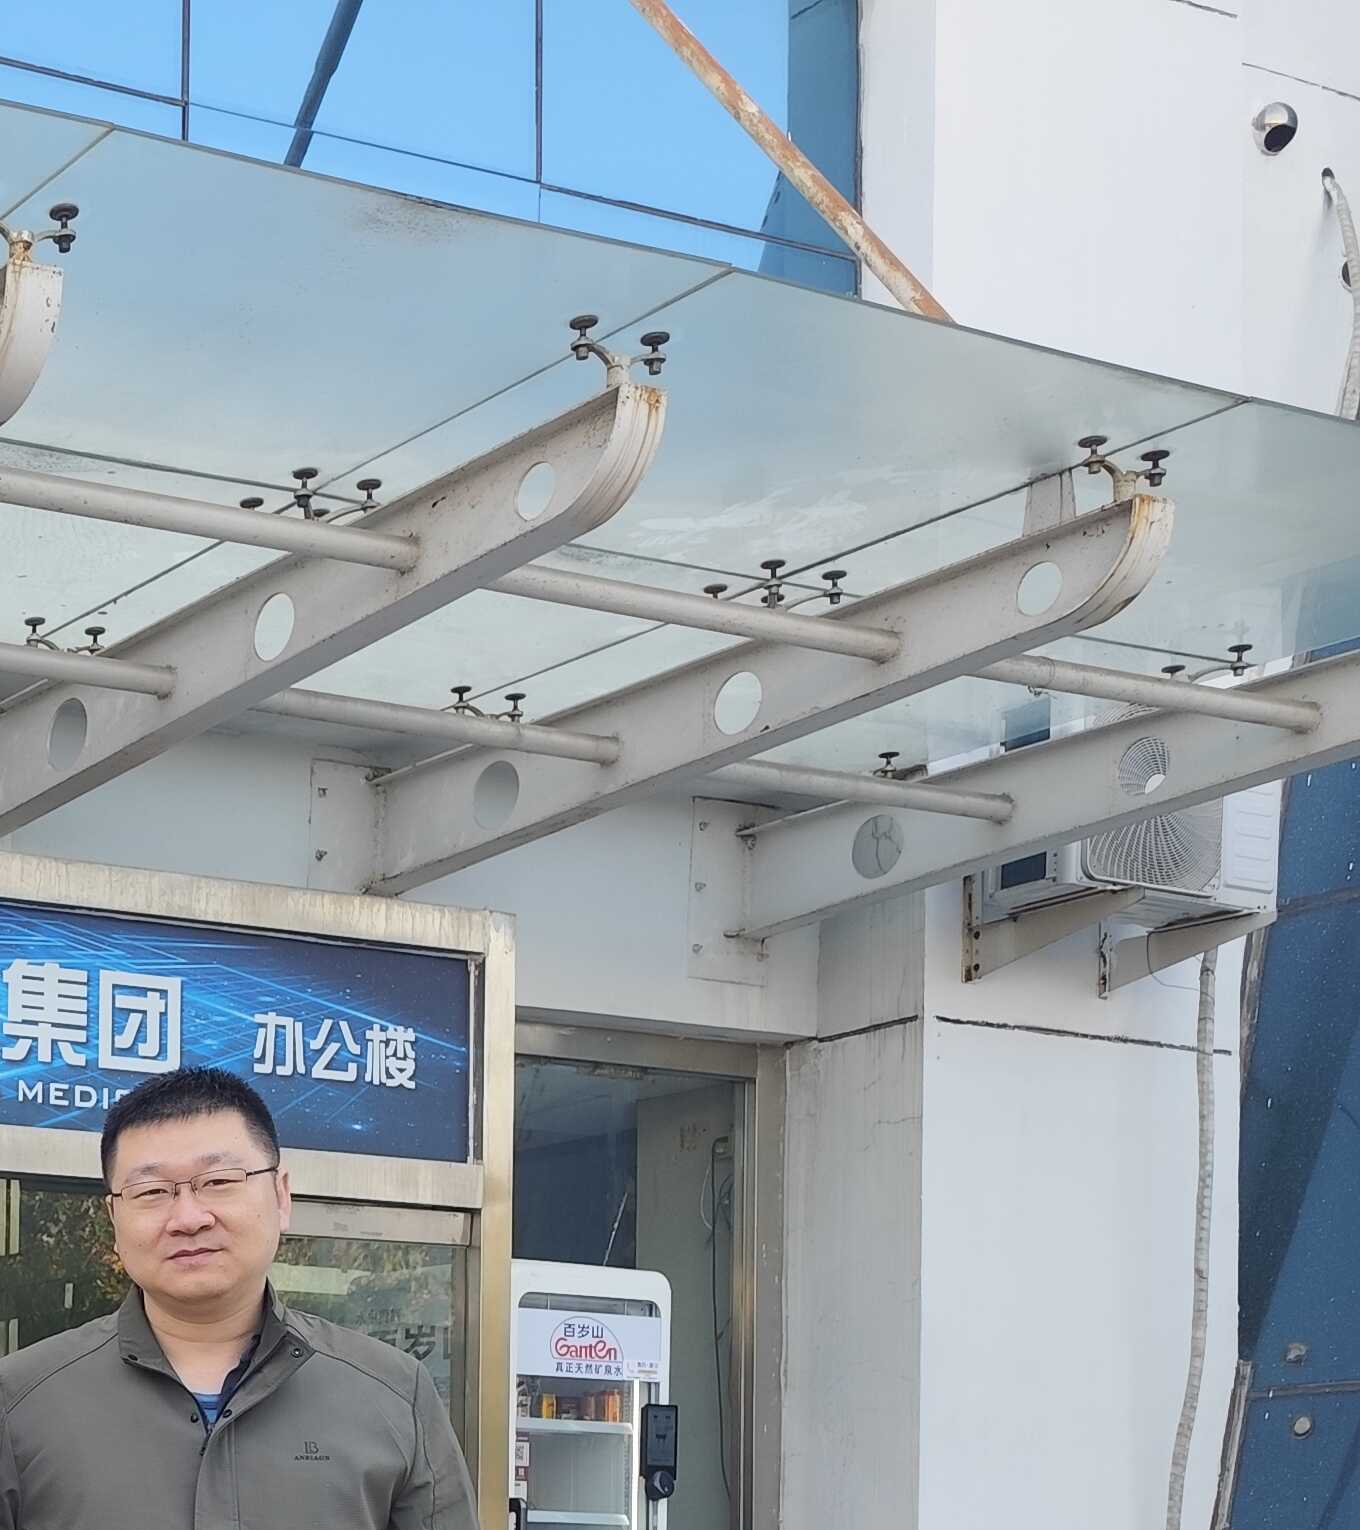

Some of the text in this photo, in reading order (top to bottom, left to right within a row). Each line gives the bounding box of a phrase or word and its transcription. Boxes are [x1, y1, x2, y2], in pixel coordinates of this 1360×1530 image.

[253, 1012, 416, 1090] 办公楼
[564, 1323, 604, 1339] 百岁山
[556, 1362, 623, 1377] 真正天然矿泉水
